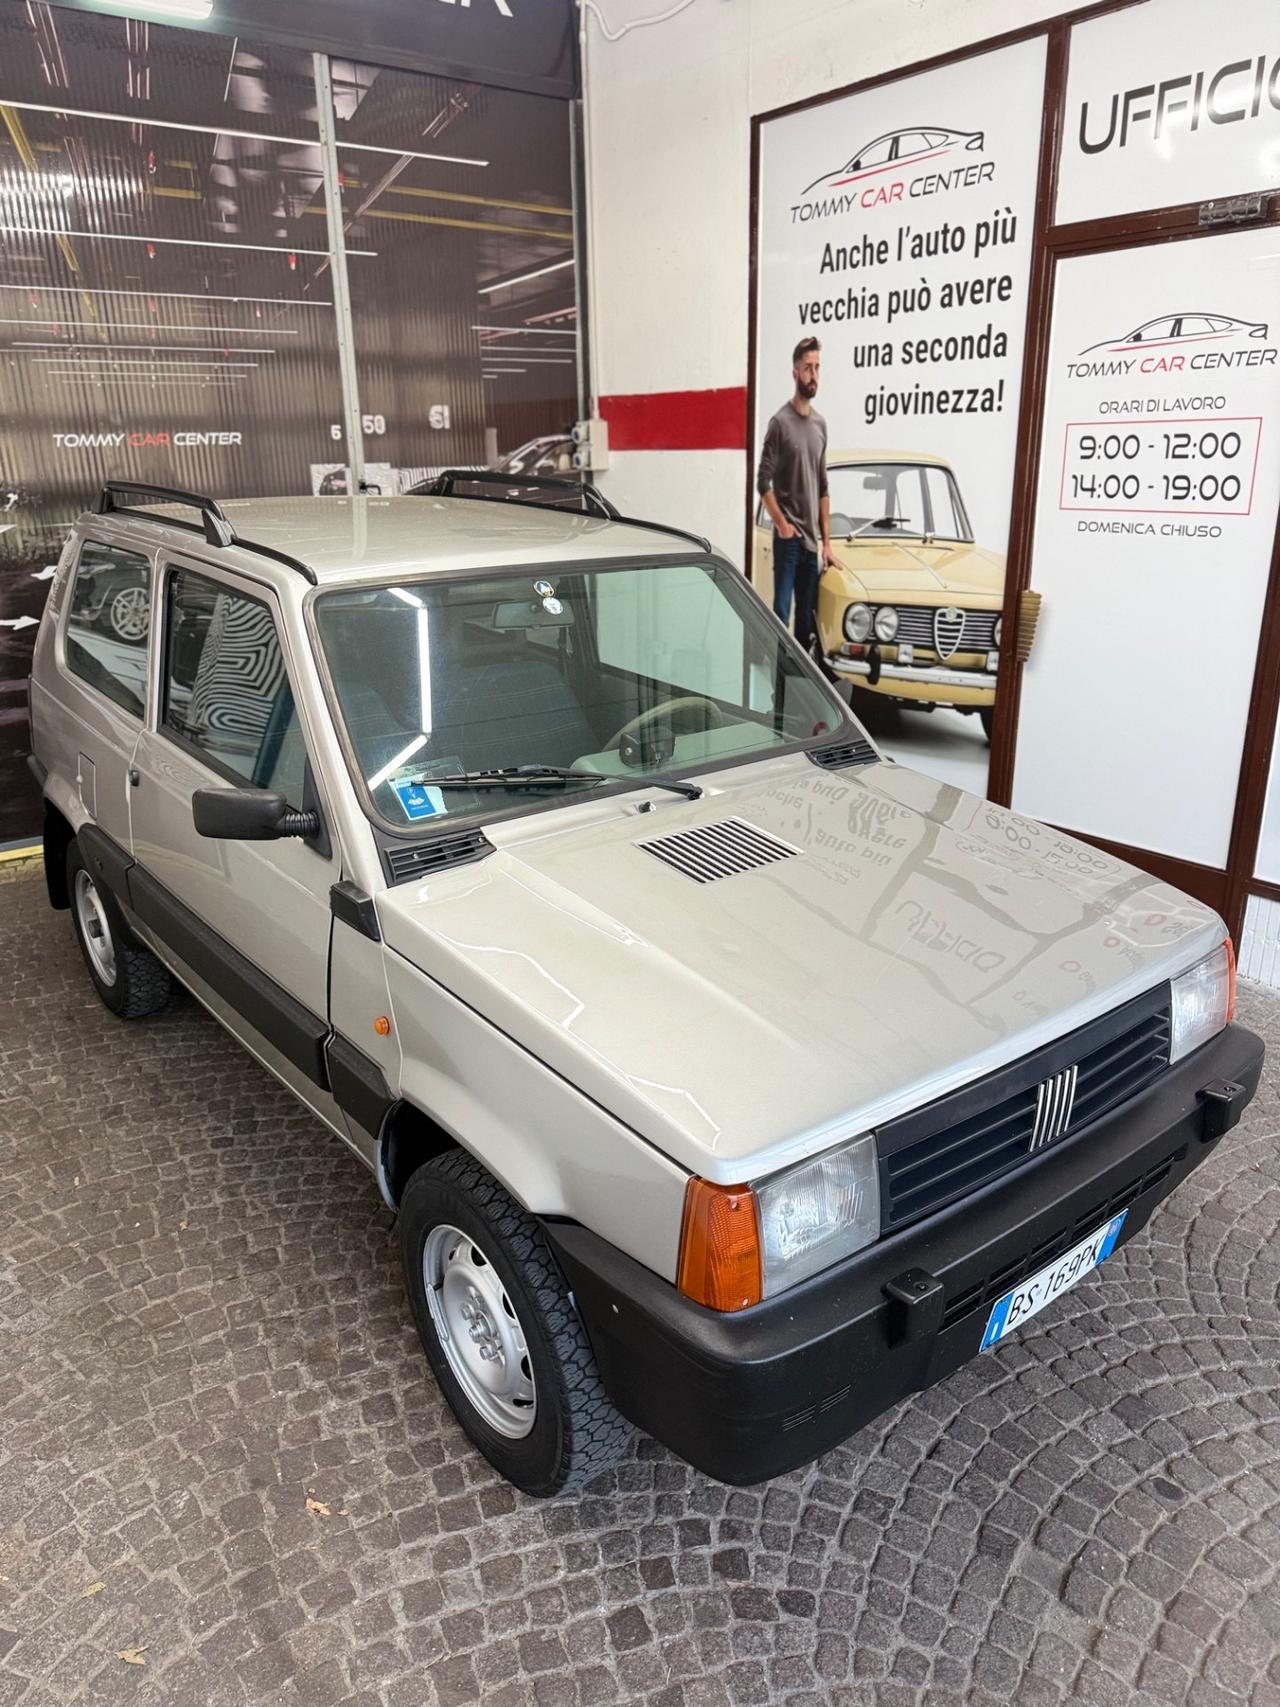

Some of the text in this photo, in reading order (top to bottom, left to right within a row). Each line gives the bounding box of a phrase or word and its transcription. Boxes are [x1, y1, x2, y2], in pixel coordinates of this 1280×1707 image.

[1079, 55, 1280, 154] UFFICI
[790, 161, 996, 224] TOMMY CAR CENTER
[819, 234, 889, 274] Anche
[974, 206, 1017, 258] più
[799, 274, 1013, 325] vecchia può avere
[853, 323, 1008, 368] una seconda
[1066, 349, 1278, 378] TOMMY CAR CENTER
[864, 379, 1005, 424] giovinezza!
[1099, 396, 1226, 414] ORARI DI LAVORO
[53, 432, 242, 448] TOMMY CAR CENTER
[1079, 434, 1140, 460] 9:00
[1163, 432, 1241, 459] 12:00
[1072, 474, 1140, 499] 14:00
[1163, 474, 1241, 501] 19:00
[1077, 521, 1222, 538] DOMENICA CHIUSO
[1007, 1284, 1039, 1326] BS
[1044, 1235, 1106, 1300] 169PK
